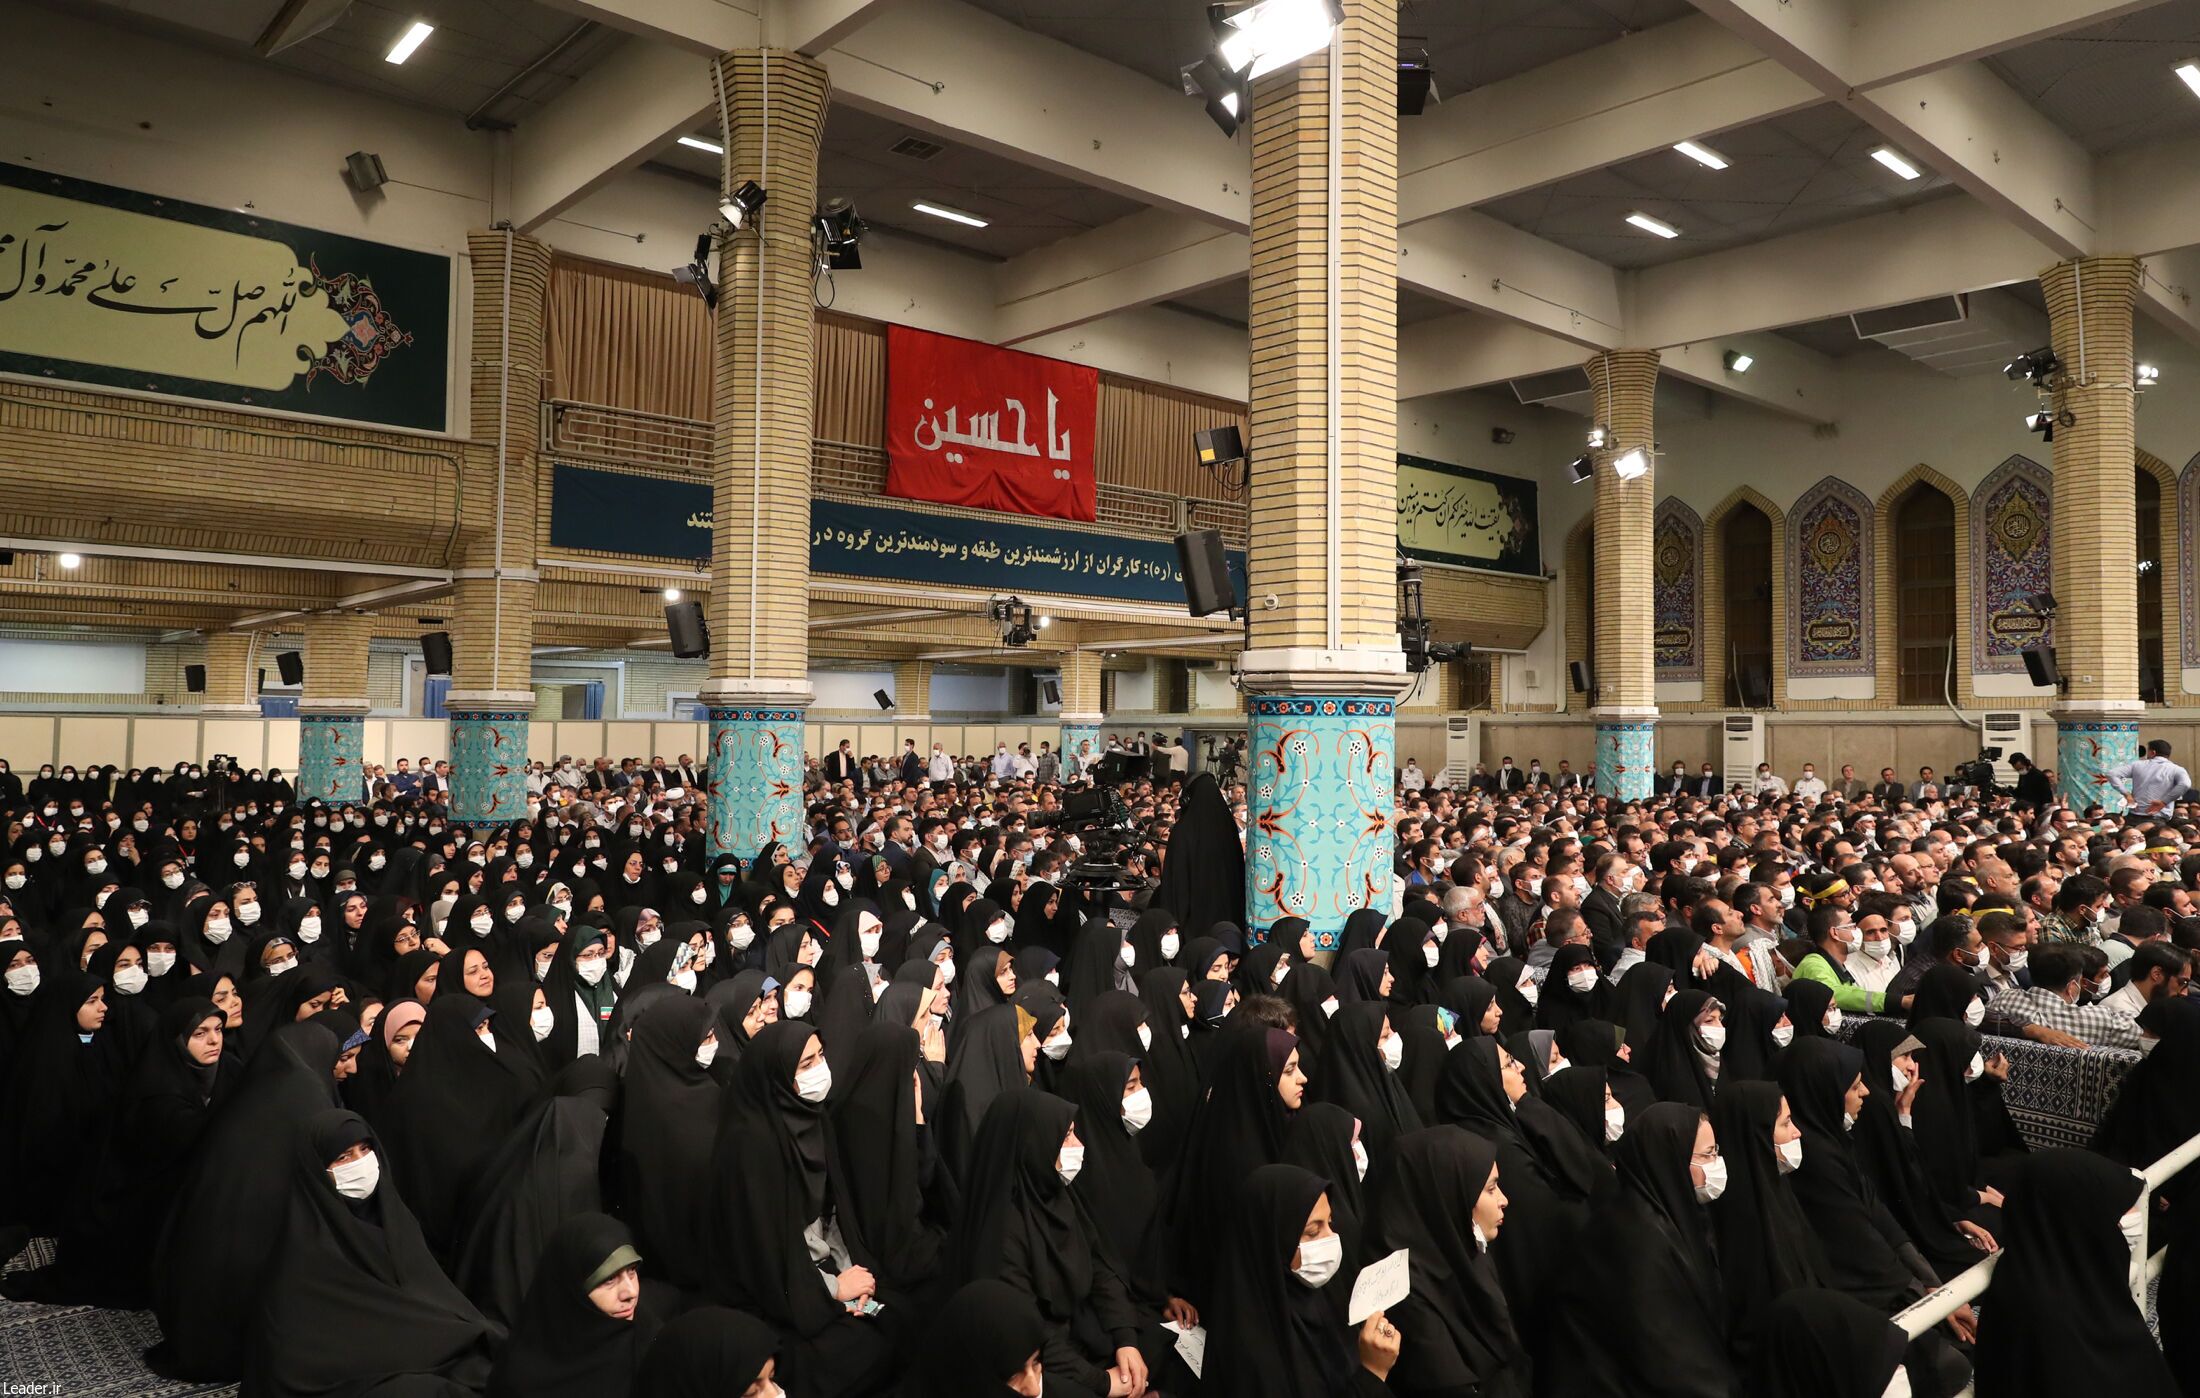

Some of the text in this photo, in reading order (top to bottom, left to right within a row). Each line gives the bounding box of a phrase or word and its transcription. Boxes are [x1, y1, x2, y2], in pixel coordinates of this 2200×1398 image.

[913, 386, 1072, 481] یا حسین
[686, 511, 714, 529] تند
[812, 526, 833, 546] در
[837, 527, 872, 551] گروه
[875, 530, 957, 559] سودمندترین
[958, 545, 969, 561] و
[971, 540, 1001, 564] طبقه
[1003, 544, 1079, 572] ارزشمندترین
[1082, 553, 1094, 574] از
[1096, 555, 1142, 577] کارگران
